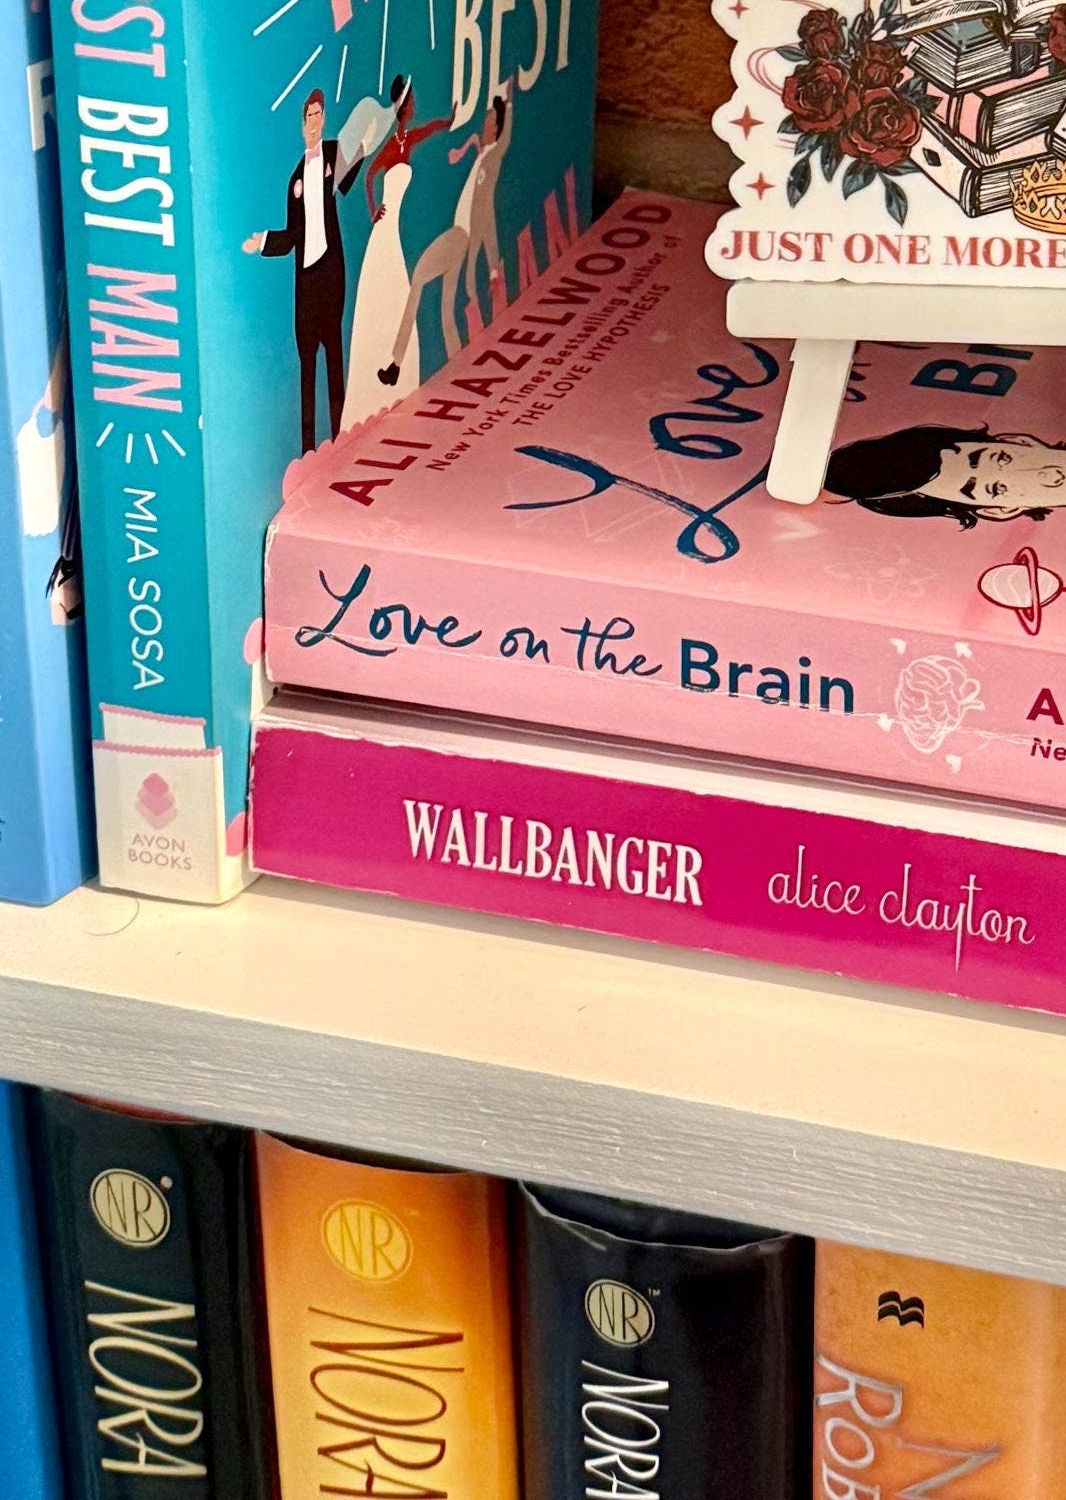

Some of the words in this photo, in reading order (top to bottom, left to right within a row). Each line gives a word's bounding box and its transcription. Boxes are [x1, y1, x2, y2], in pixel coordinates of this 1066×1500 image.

[76, 93, 176, 248] BEST
[720, 229, 834, 264] JUST
[843, 232, 933, 267] ONE
[86, 262, 184, 415] MAN
[327, 438, 433, 508] ALI
[413, 203, 673, 422] HAZELWOOD
[424, 440, 471, 472] New
[461, 406, 510, 438] York
[500, 366, 553, 406] Times
[542, 296, 630, 367] Bestselling
[617, 250, 668, 295] Author
[511, 400, 555, 428] THE
[544, 364, 593, 399] LOVE
[588, 283, 672, 363] HYPOTHESIS
[503, 340, 781, 564] Love
[122, 486, 160, 565] MIA
[127, 576, 166, 691] SOSA
[295, 563, 482, 659] Love
[499, 626, 551, 665] on
[560, 616, 663, 678] the
[679, 637, 856, 716] Brain
[127, 848, 193, 872] BOOKS
[131, 832, 187, 854] AVON
[402, 798, 704, 906] WALLBANGER
[766, 845, 866, 916] alice
[878, 862, 1037, 972] clayton
[83, 1280, 208, 1479] NORA
[307, 1305, 466, 1500] NORA
[580, 1359, 670, 1500] NORA
